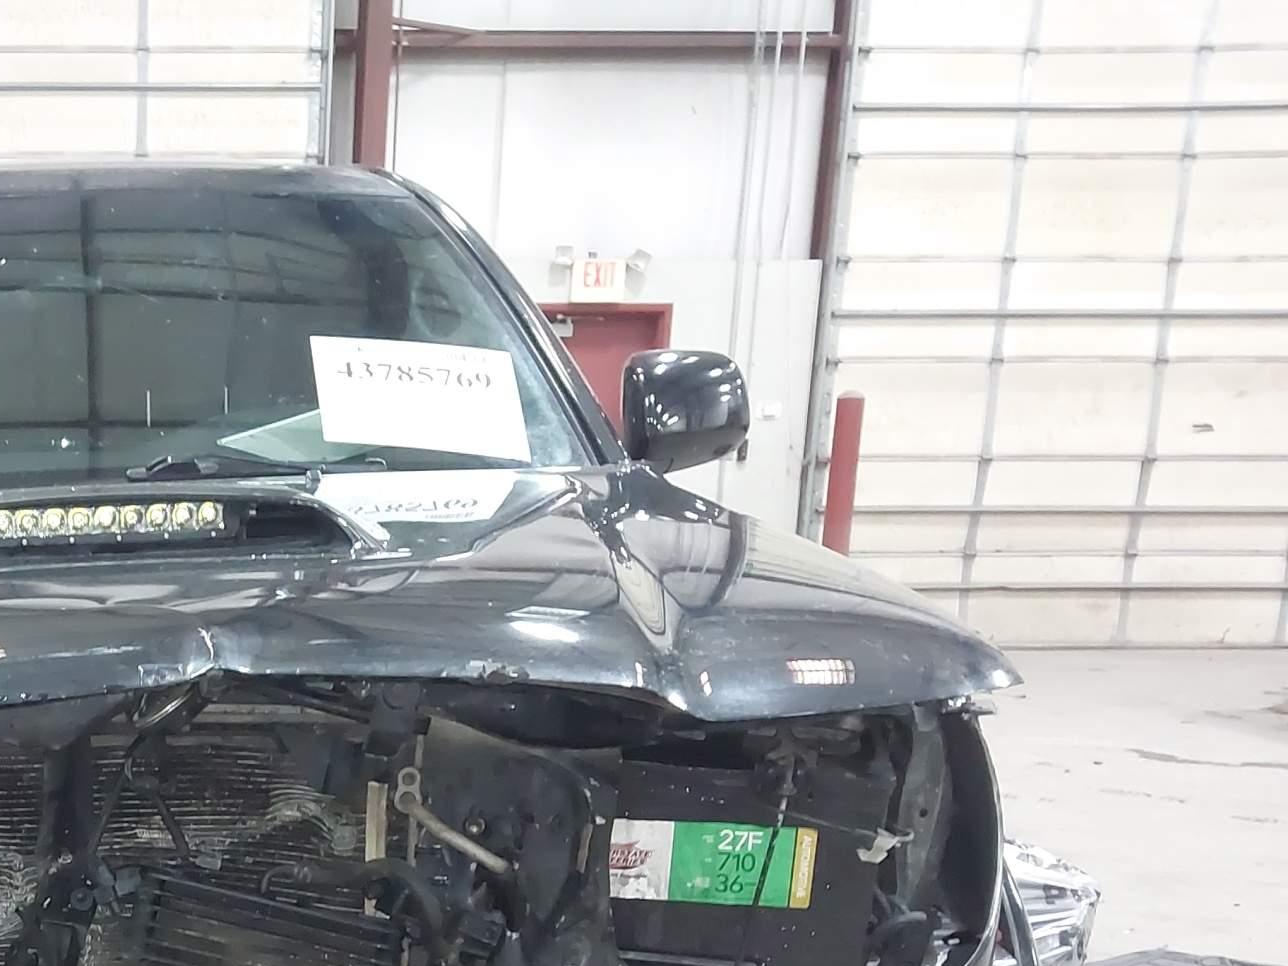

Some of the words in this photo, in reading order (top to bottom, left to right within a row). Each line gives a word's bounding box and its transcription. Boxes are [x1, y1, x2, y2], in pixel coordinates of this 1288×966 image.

[583, 261, 616, 288] EXIT
[717, 829, 764, 852] 27F
[717, 851, 756, 873] 710
